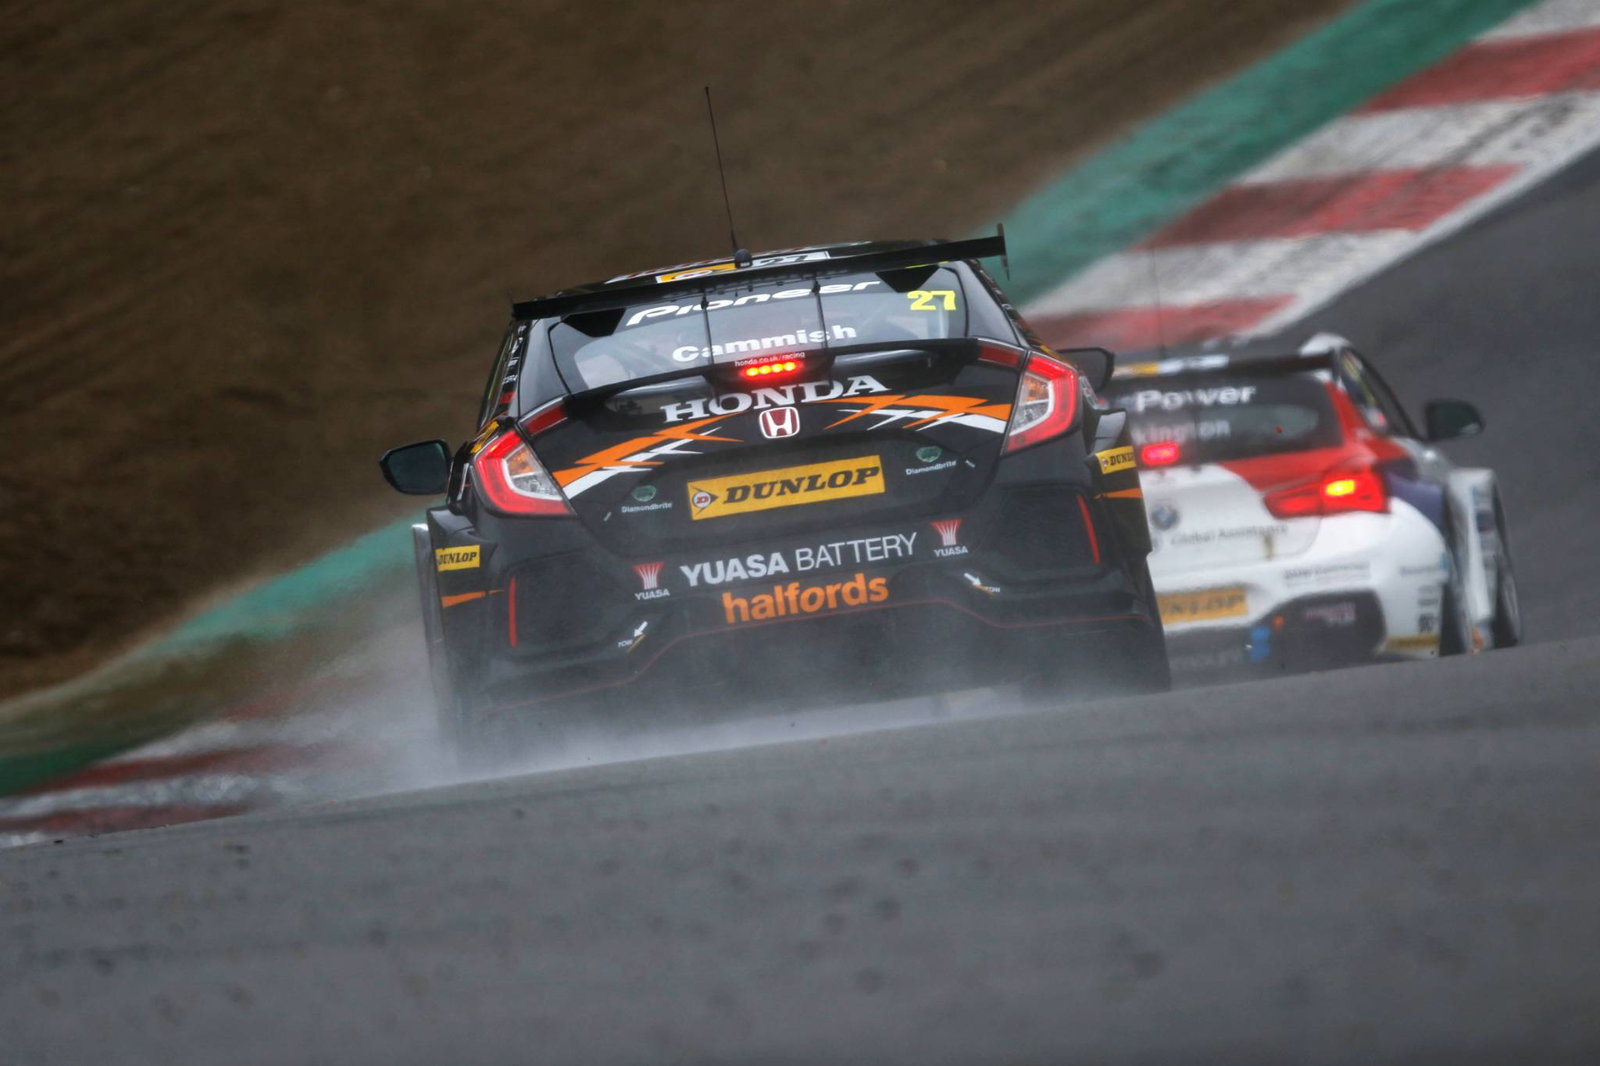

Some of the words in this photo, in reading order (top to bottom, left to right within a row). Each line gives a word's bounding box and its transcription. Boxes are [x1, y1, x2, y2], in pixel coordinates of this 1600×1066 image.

[626, 280, 881, 326] Pioneer
[907, 289, 957, 311] 27
[672, 324, 857, 363] Cammish
[660, 375, 892, 423] HONDA
[723, 466, 880, 504] DUNLOP
[679, 552, 788, 587] YUASA
[795, 532, 917, 571] BATTERY
[934, 545, 968, 558] YUASA
[635, 588, 670, 601] YUASA
[722, 573, 888, 624] halfords
